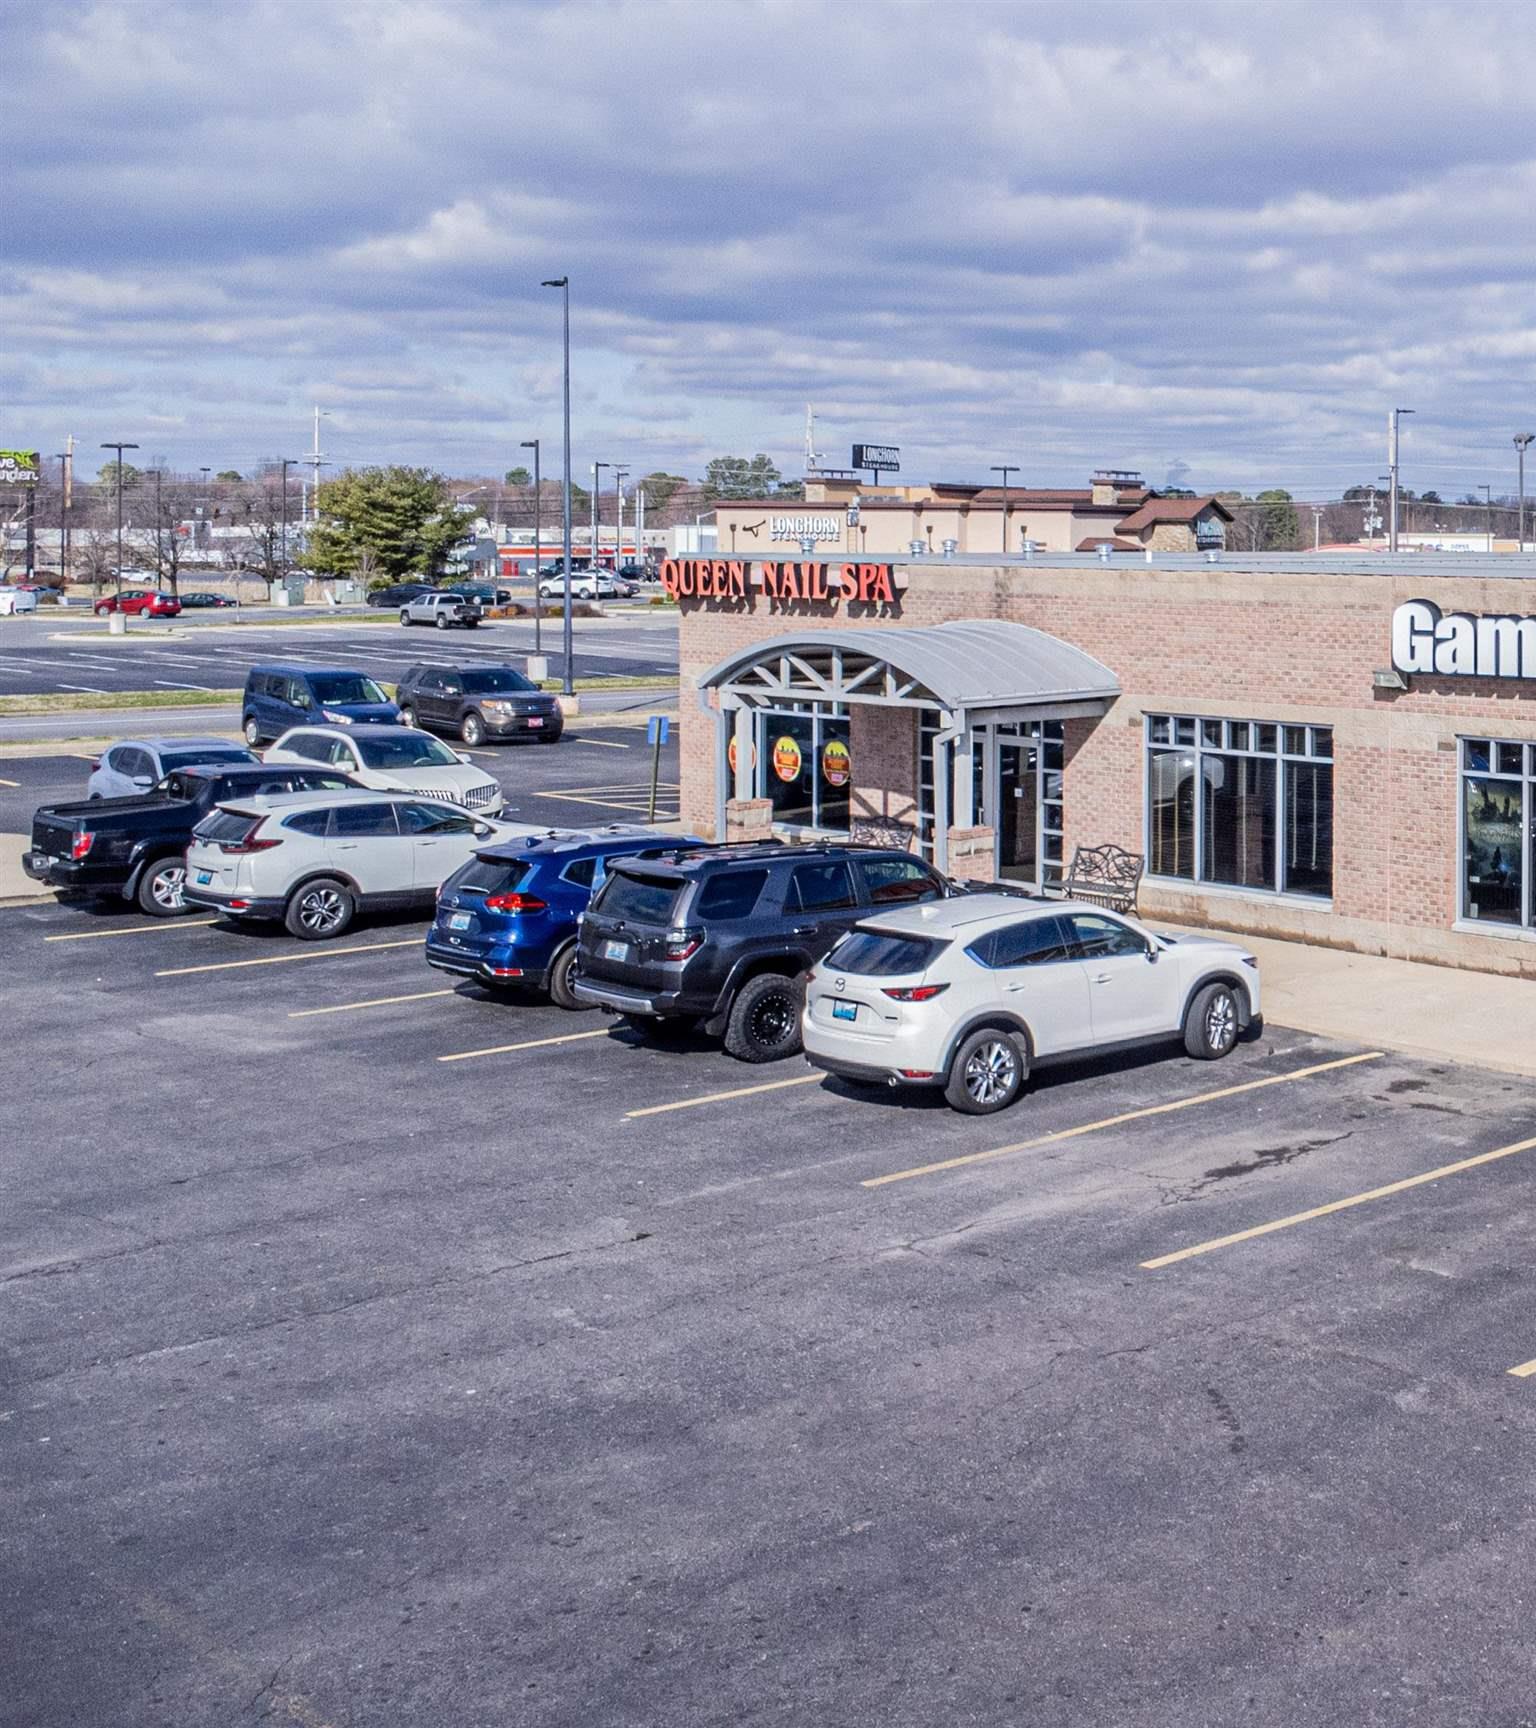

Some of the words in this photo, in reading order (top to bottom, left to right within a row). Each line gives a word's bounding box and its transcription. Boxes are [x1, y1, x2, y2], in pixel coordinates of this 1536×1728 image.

[862, 445, 900, 463] LONGHORN
[769, 515, 839, 533] LONGHORN
[769, 532, 841, 542] STEAKHOUSE
[659, 559, 746, 600] QUEEN
[761, 560, 829, 599] NAIL
[839, 562, 894, 601] SPA
